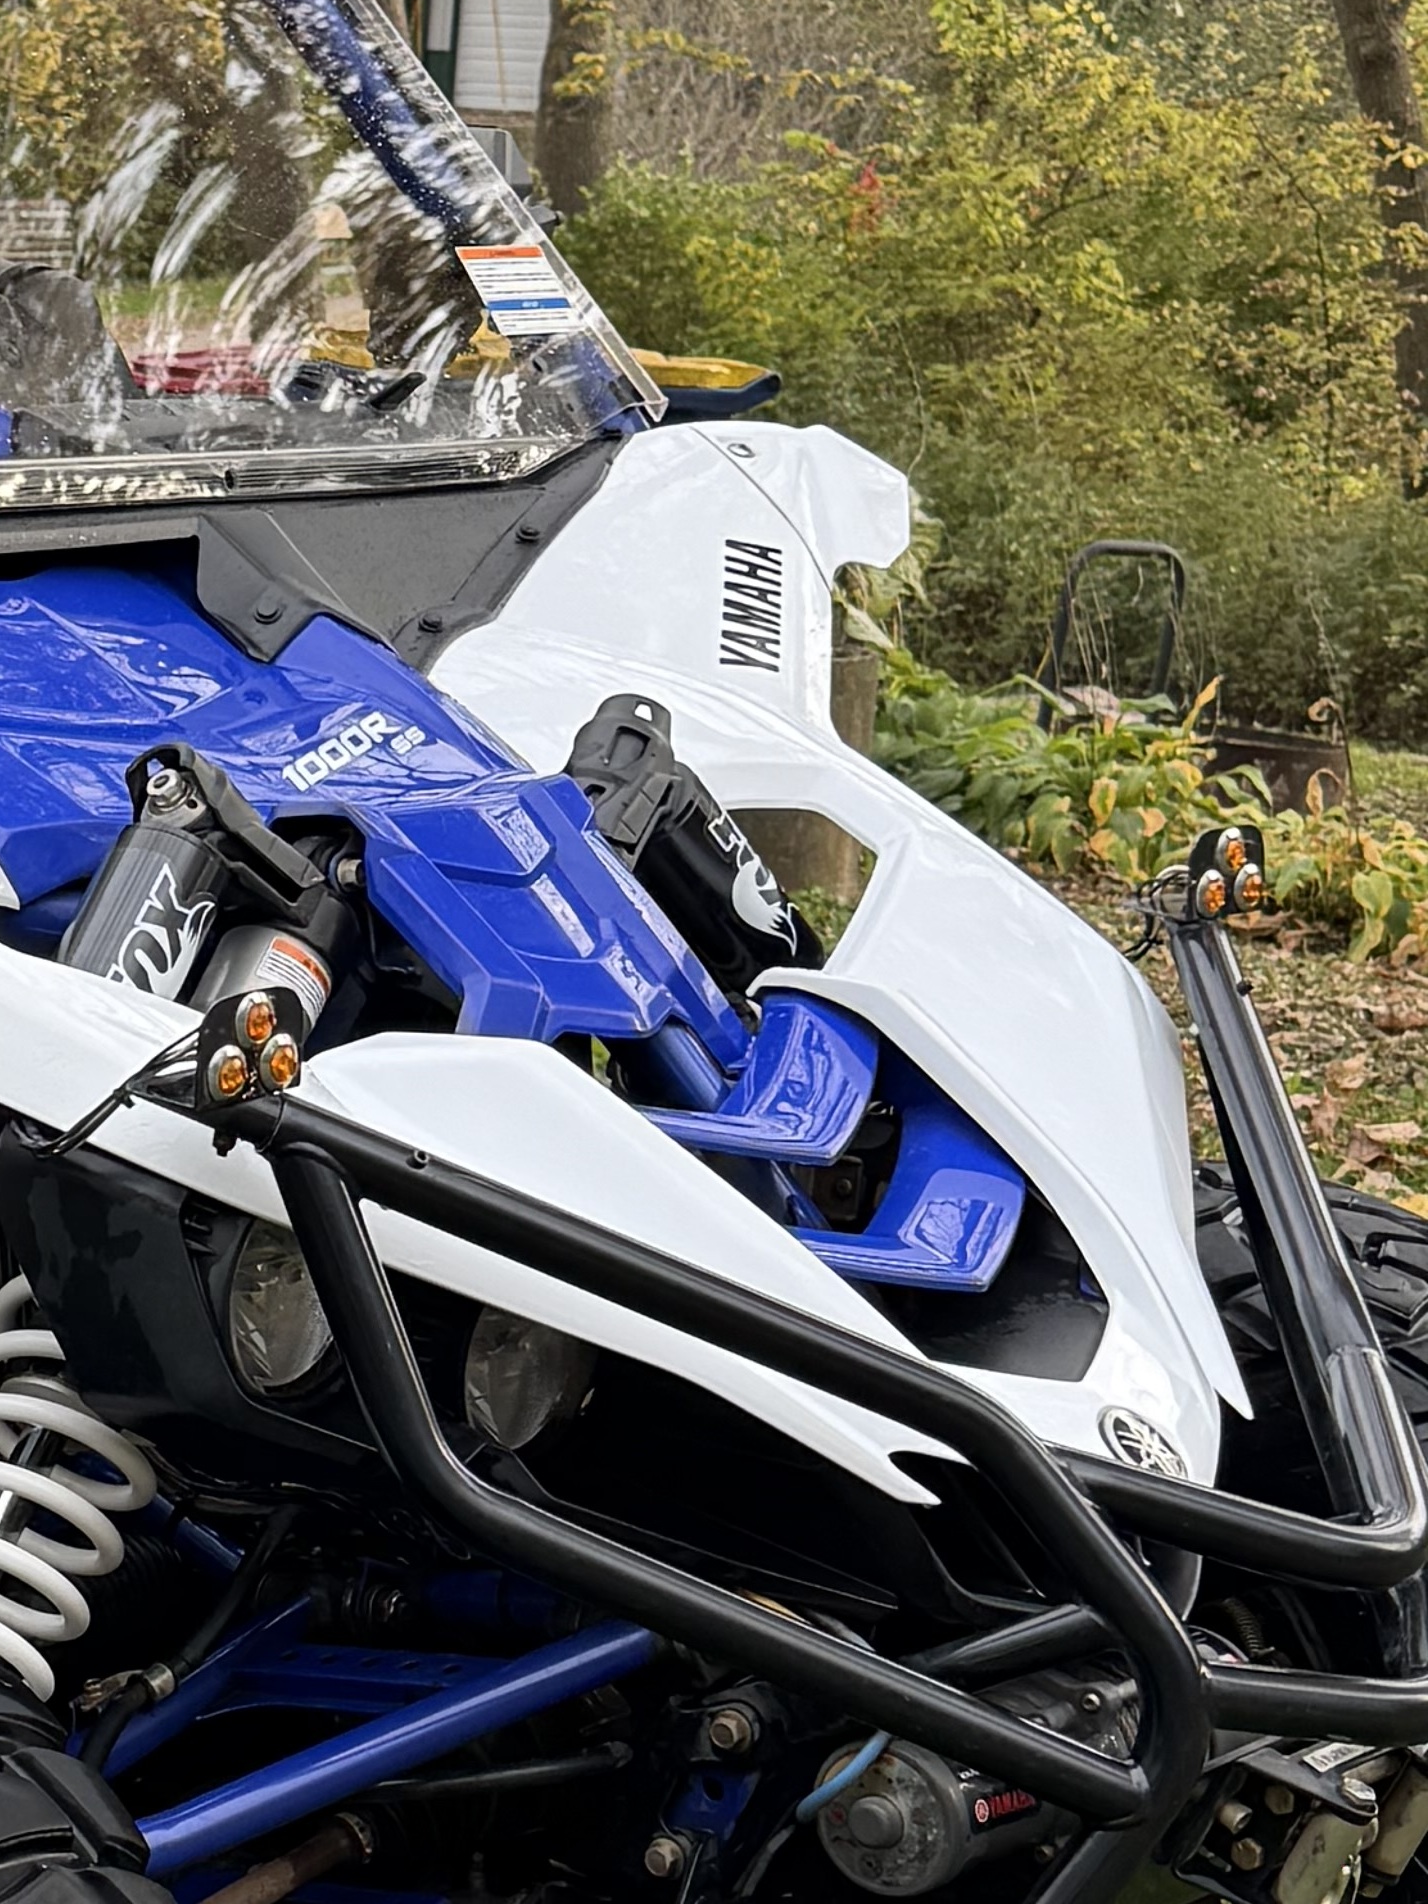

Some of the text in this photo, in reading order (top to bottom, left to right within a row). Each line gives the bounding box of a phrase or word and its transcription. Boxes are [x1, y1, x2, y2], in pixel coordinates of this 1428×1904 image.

[719, 538, 783, 674] YAMAHA
[280, 710, 428, 794] 1000R SS
